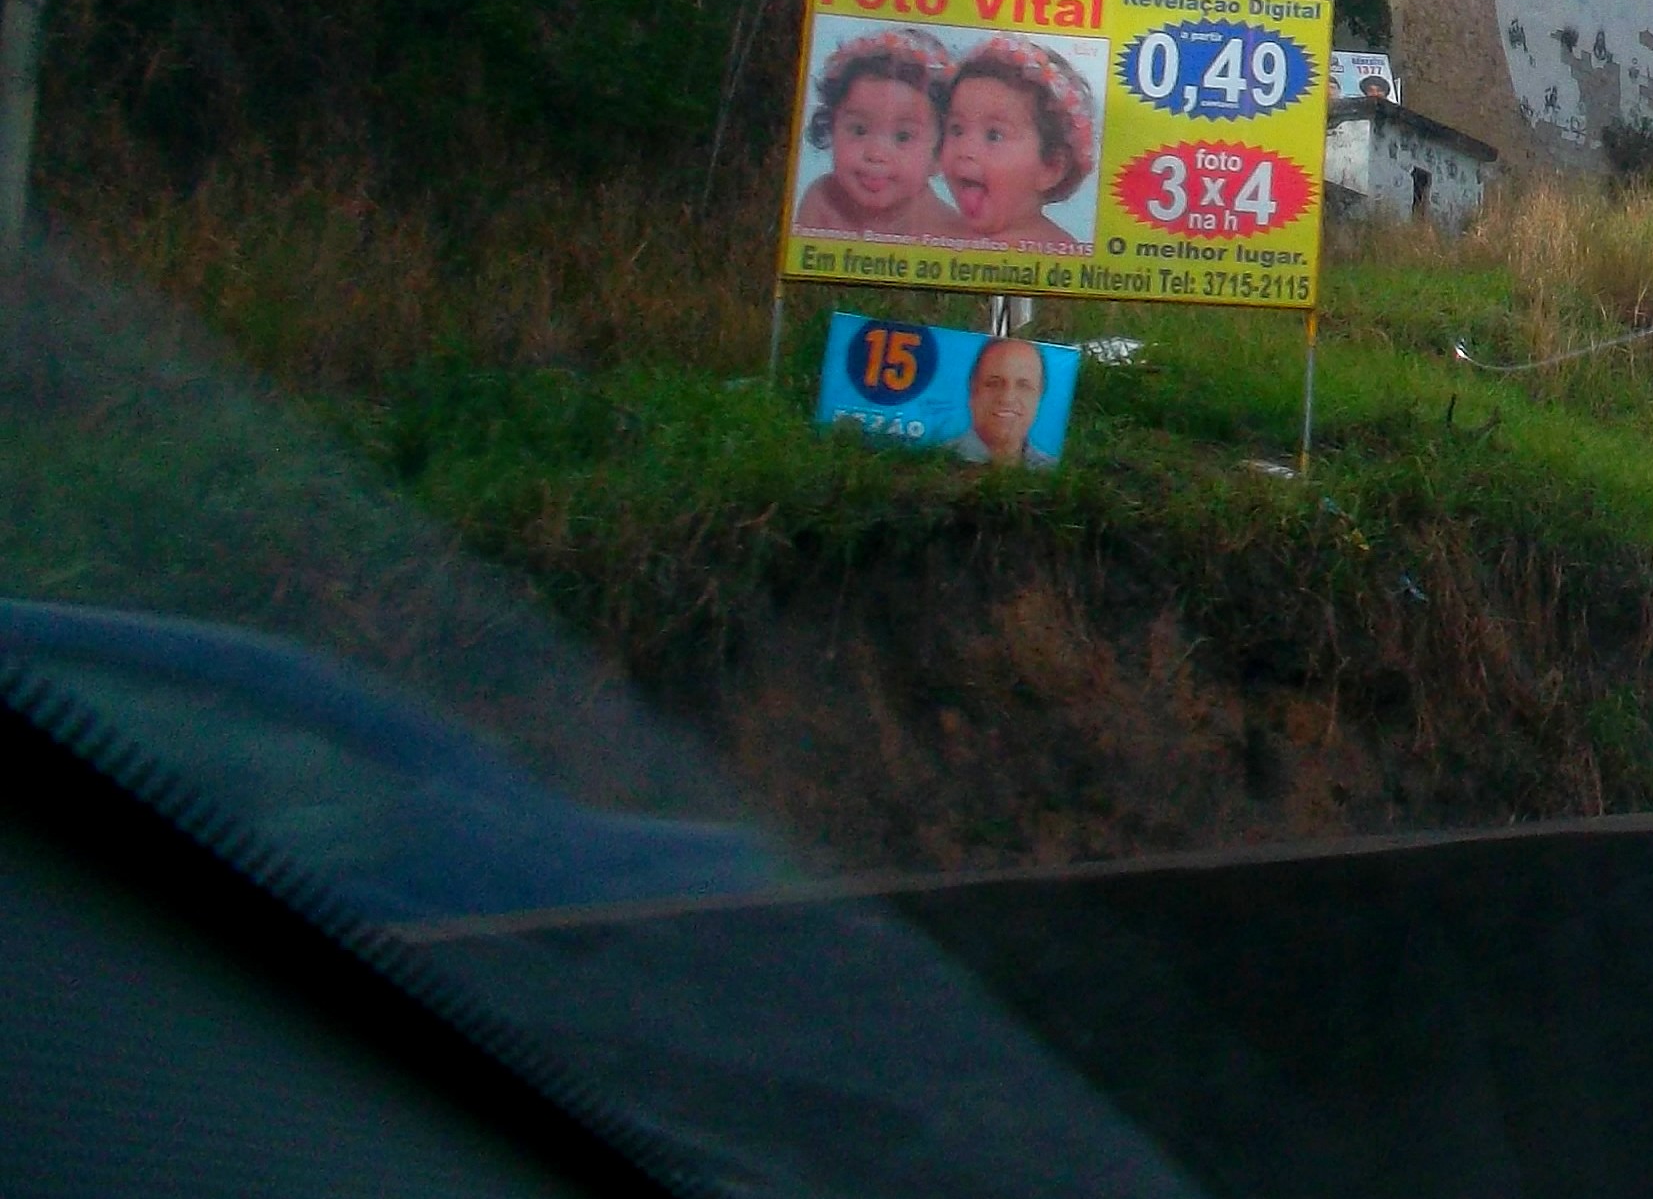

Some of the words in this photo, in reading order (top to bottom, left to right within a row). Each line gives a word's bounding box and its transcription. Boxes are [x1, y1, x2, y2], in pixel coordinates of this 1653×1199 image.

[1250, 0, 1320, 20] Digital
[1138, 32, 1287, 112] 0,49
[1195, 149, 1242, 172] foto
[1147, 155, 1188, 221] 3
[1234, 161, 1277, 225] 4
[1189, 213, 1216, 230] na
[1224, 210, 1238, 231] h
[802, 245, 836, 270] Em
[844, 248, 908, 276] frente
[915, 260, 942, 280] ao
[950, 257, 1040, 286] terminal
[1048, 262, 1072, 288] de
[1159, 269, 1195, 294] Tel:
[1203, 271, 1309, 300] 3715-2115
[1108, 237, 1126, 255] O
[1136, 241, 1227, 262] melhor
[1236, 244, 1307, 268] lugar.
[864, 328, 921, 391] 15
